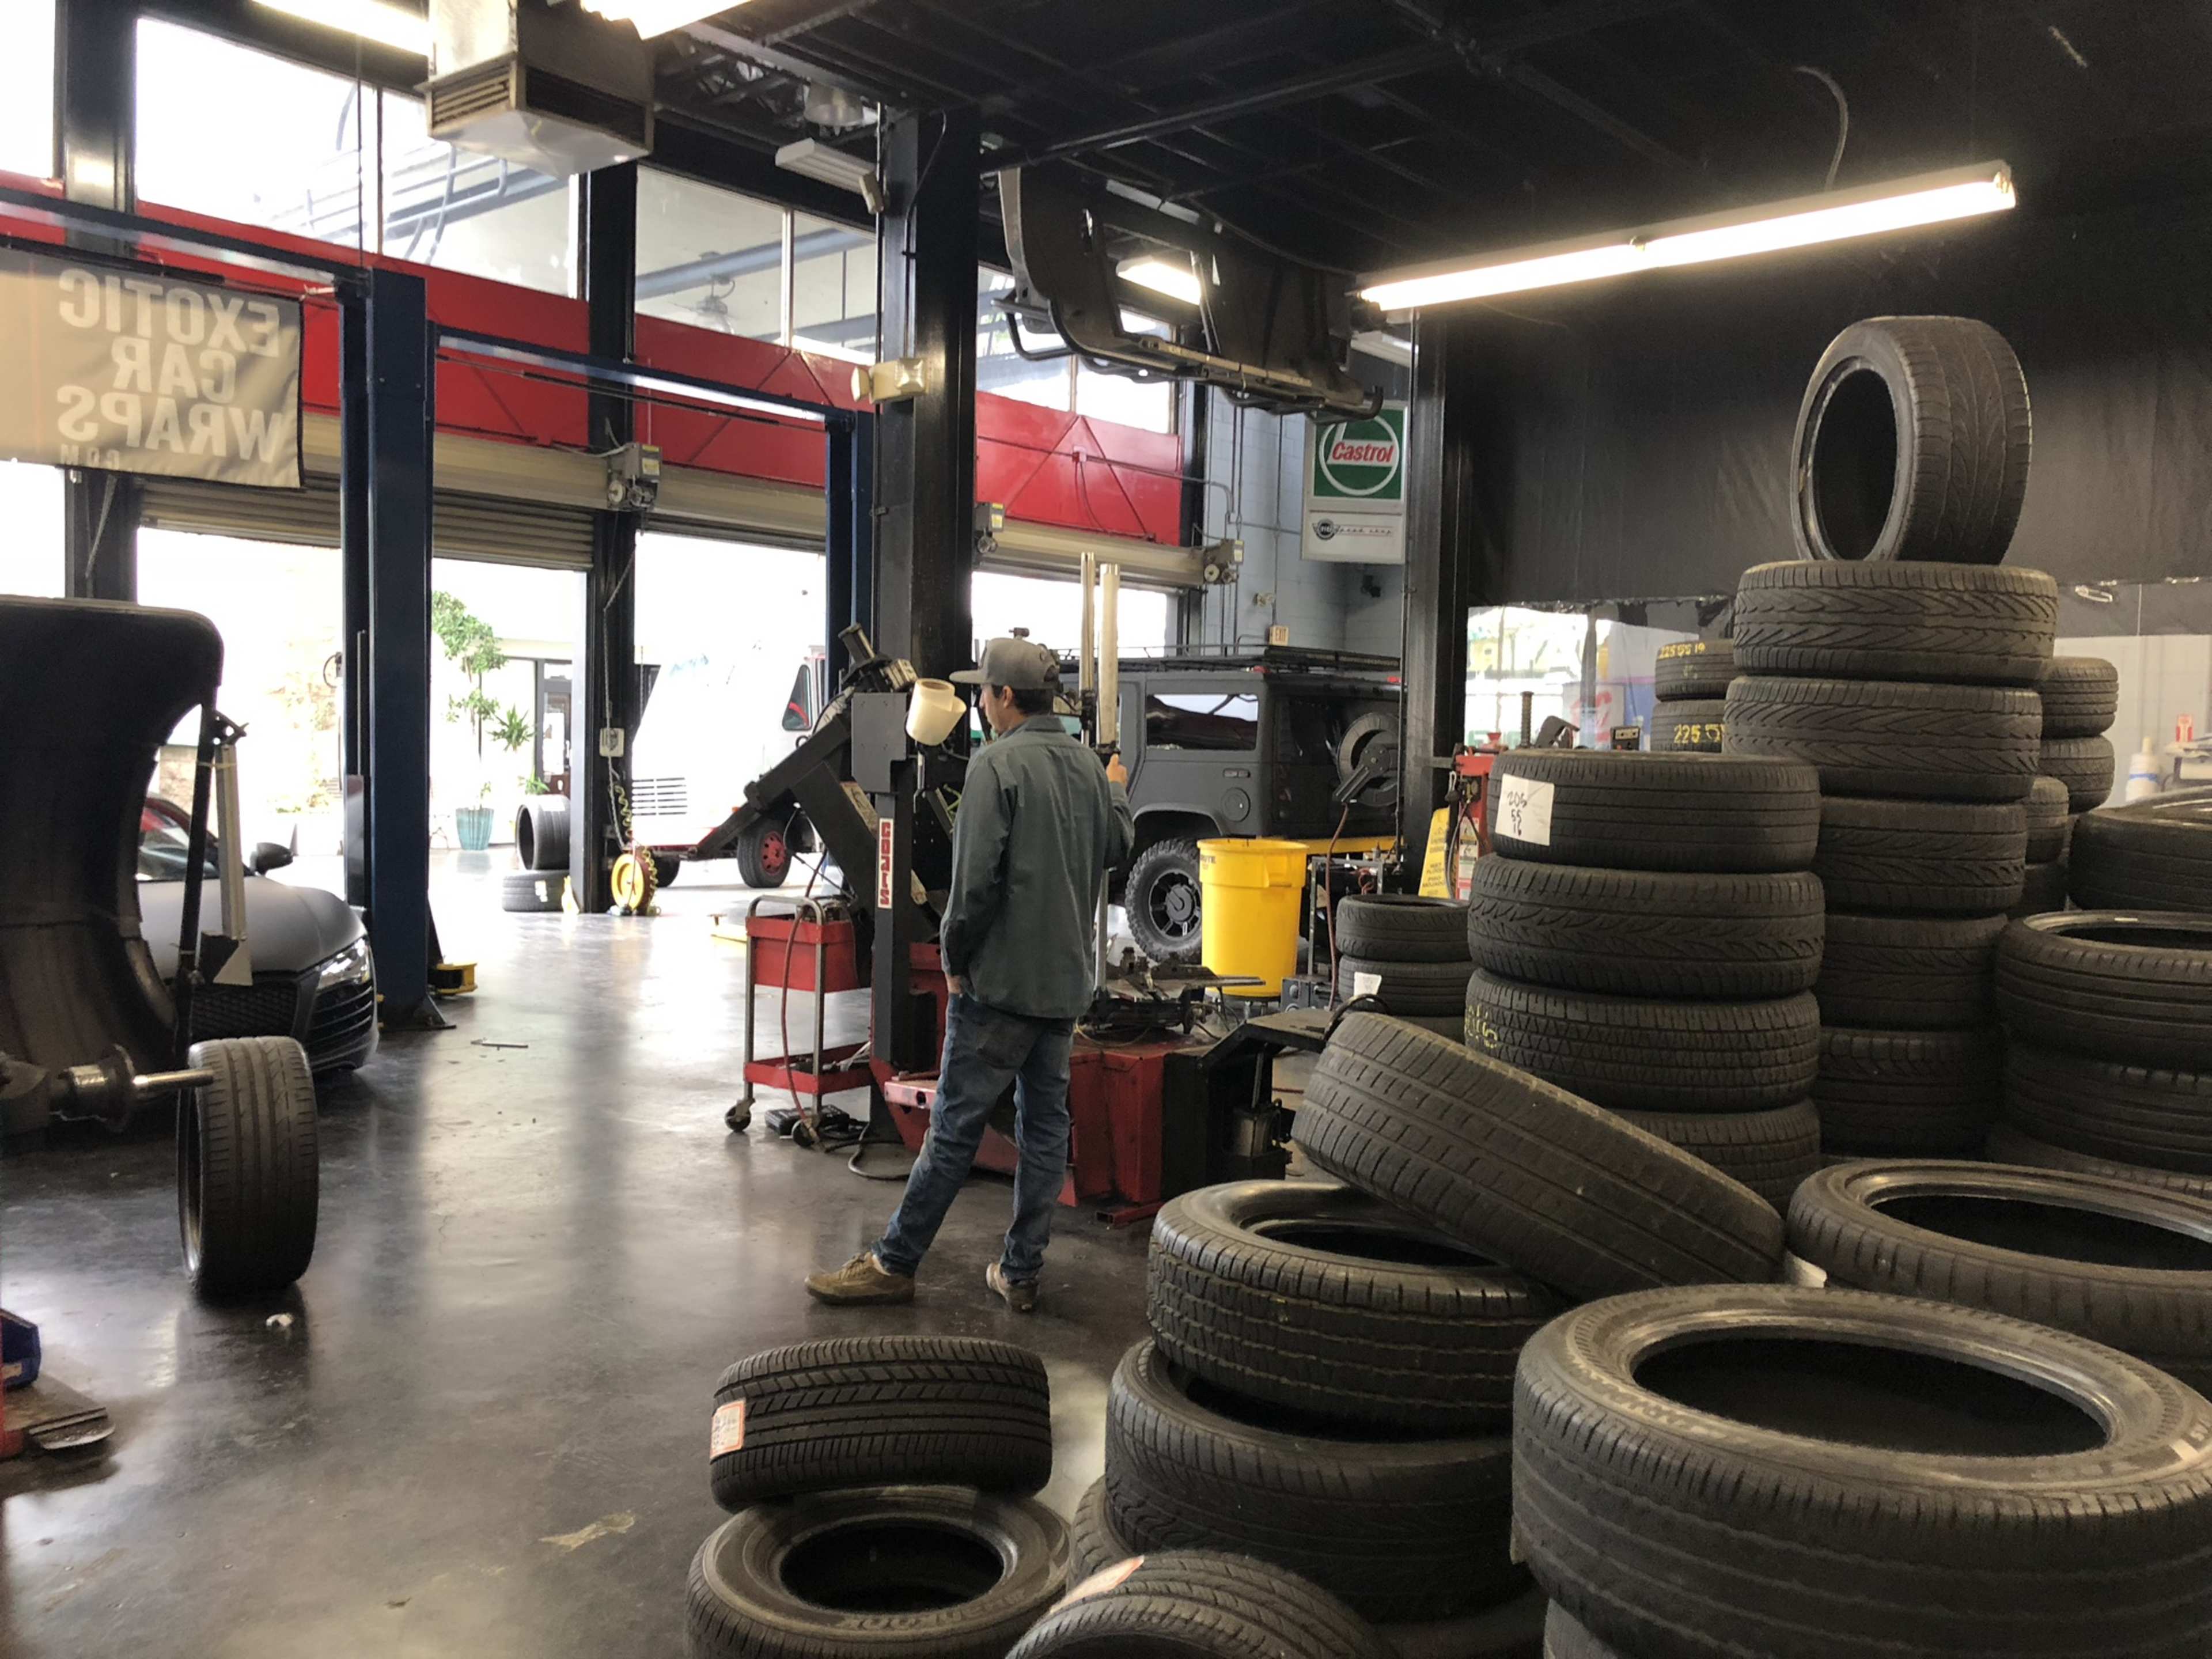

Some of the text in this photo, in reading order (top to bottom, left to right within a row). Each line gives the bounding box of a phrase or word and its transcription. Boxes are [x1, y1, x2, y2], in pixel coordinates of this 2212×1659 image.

[1332, 442, 1394, 463] Castrol
[1673, 723, 1701, 744] 225
[1507, 790, 1528, 808] 205
